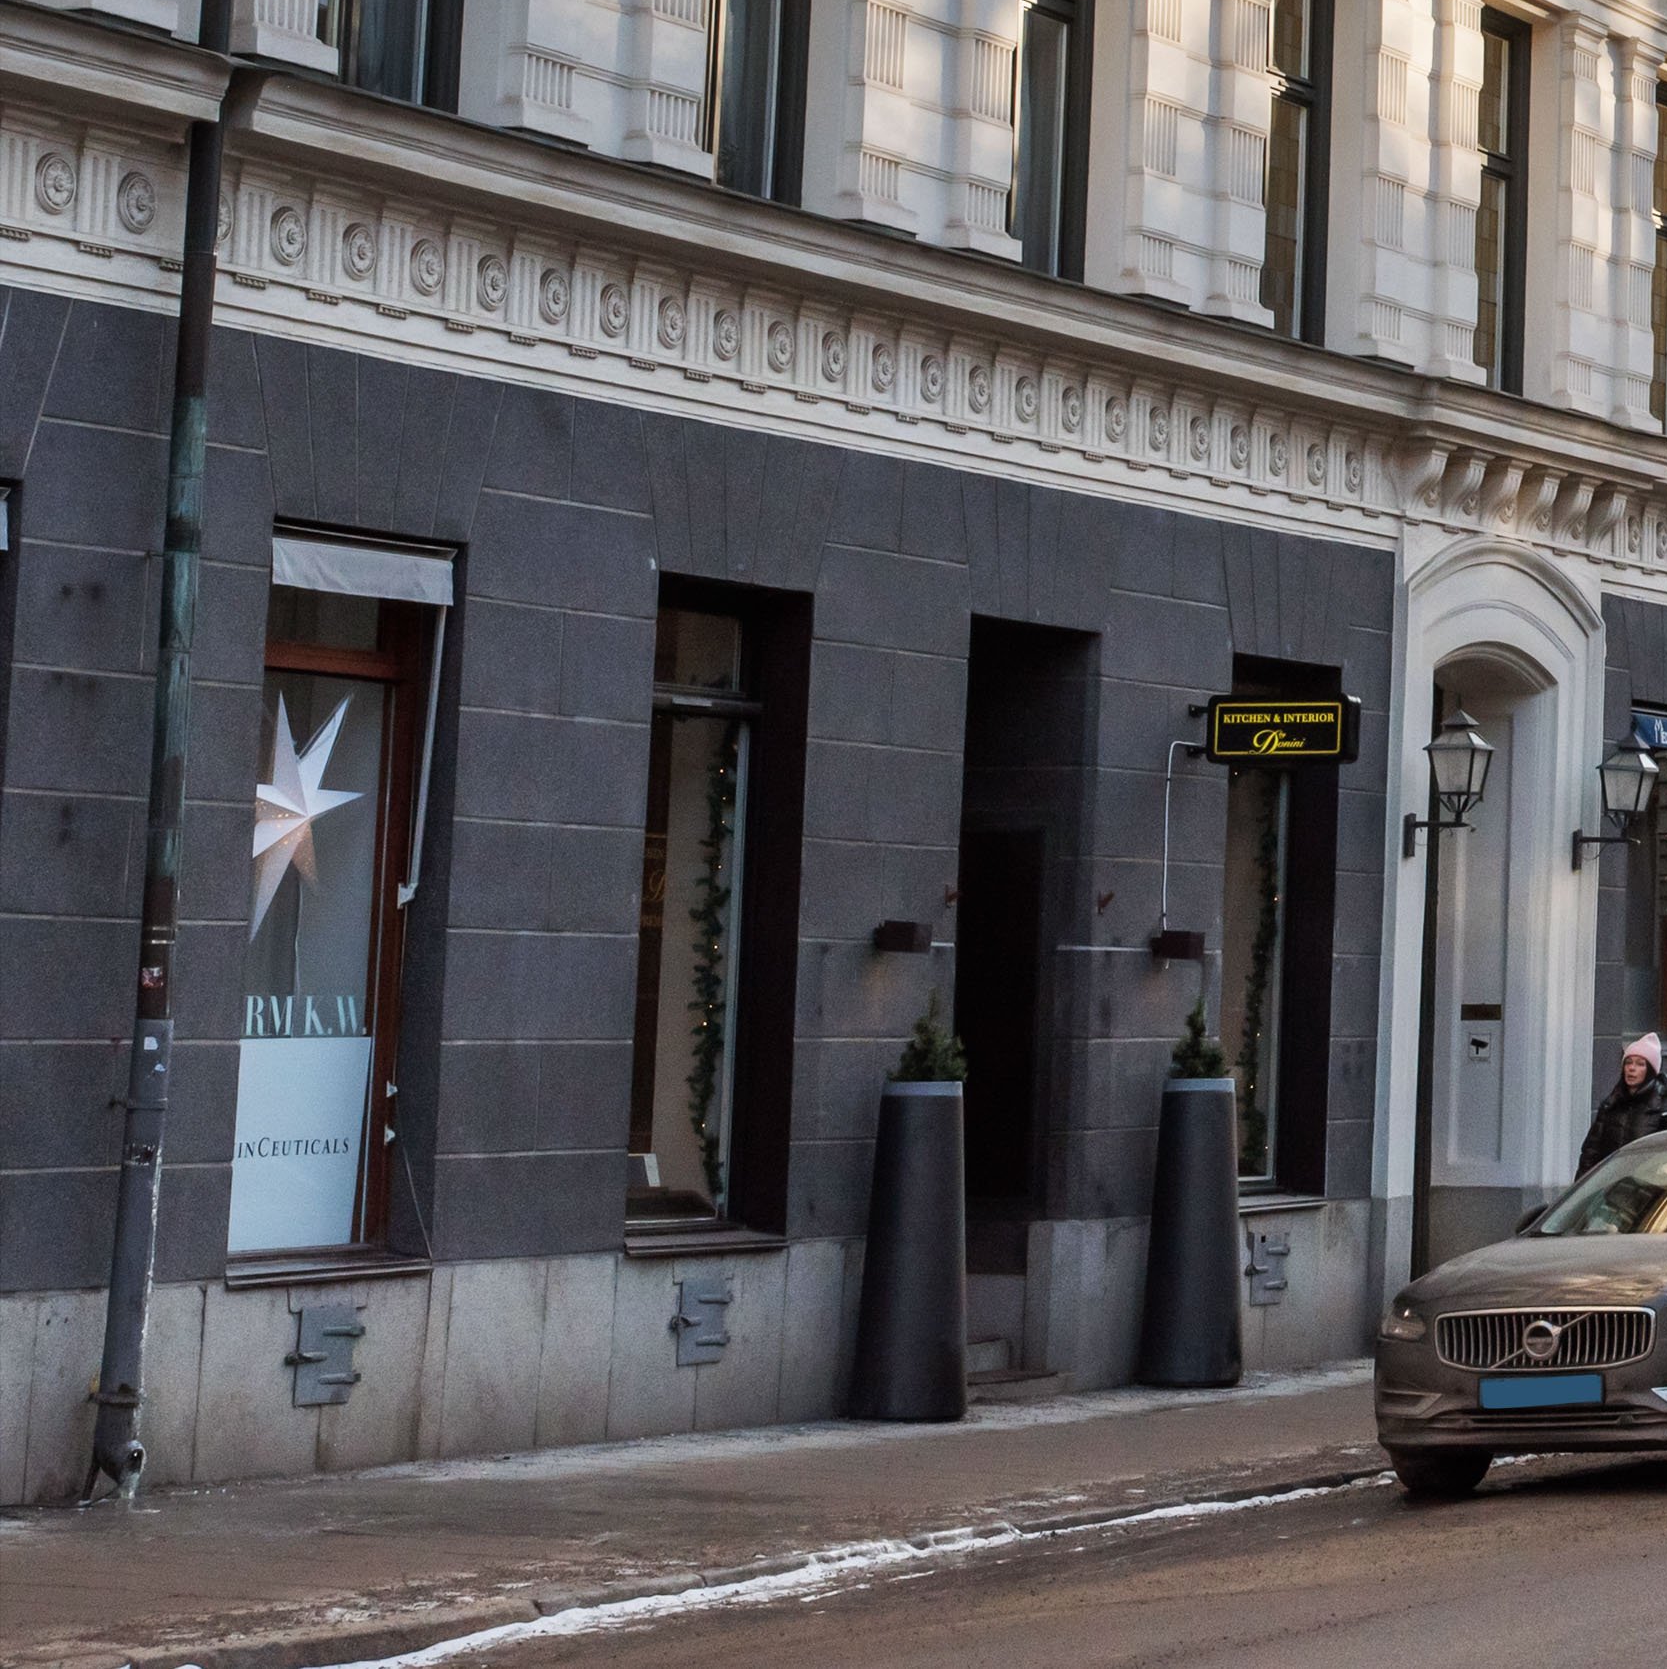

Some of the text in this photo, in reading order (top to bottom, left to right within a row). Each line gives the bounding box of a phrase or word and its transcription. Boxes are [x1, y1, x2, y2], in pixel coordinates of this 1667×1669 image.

[1223, 712, 1335, 724] KITCHEN & INTERIOR
[1249, 729, 1307, 755] Donini
